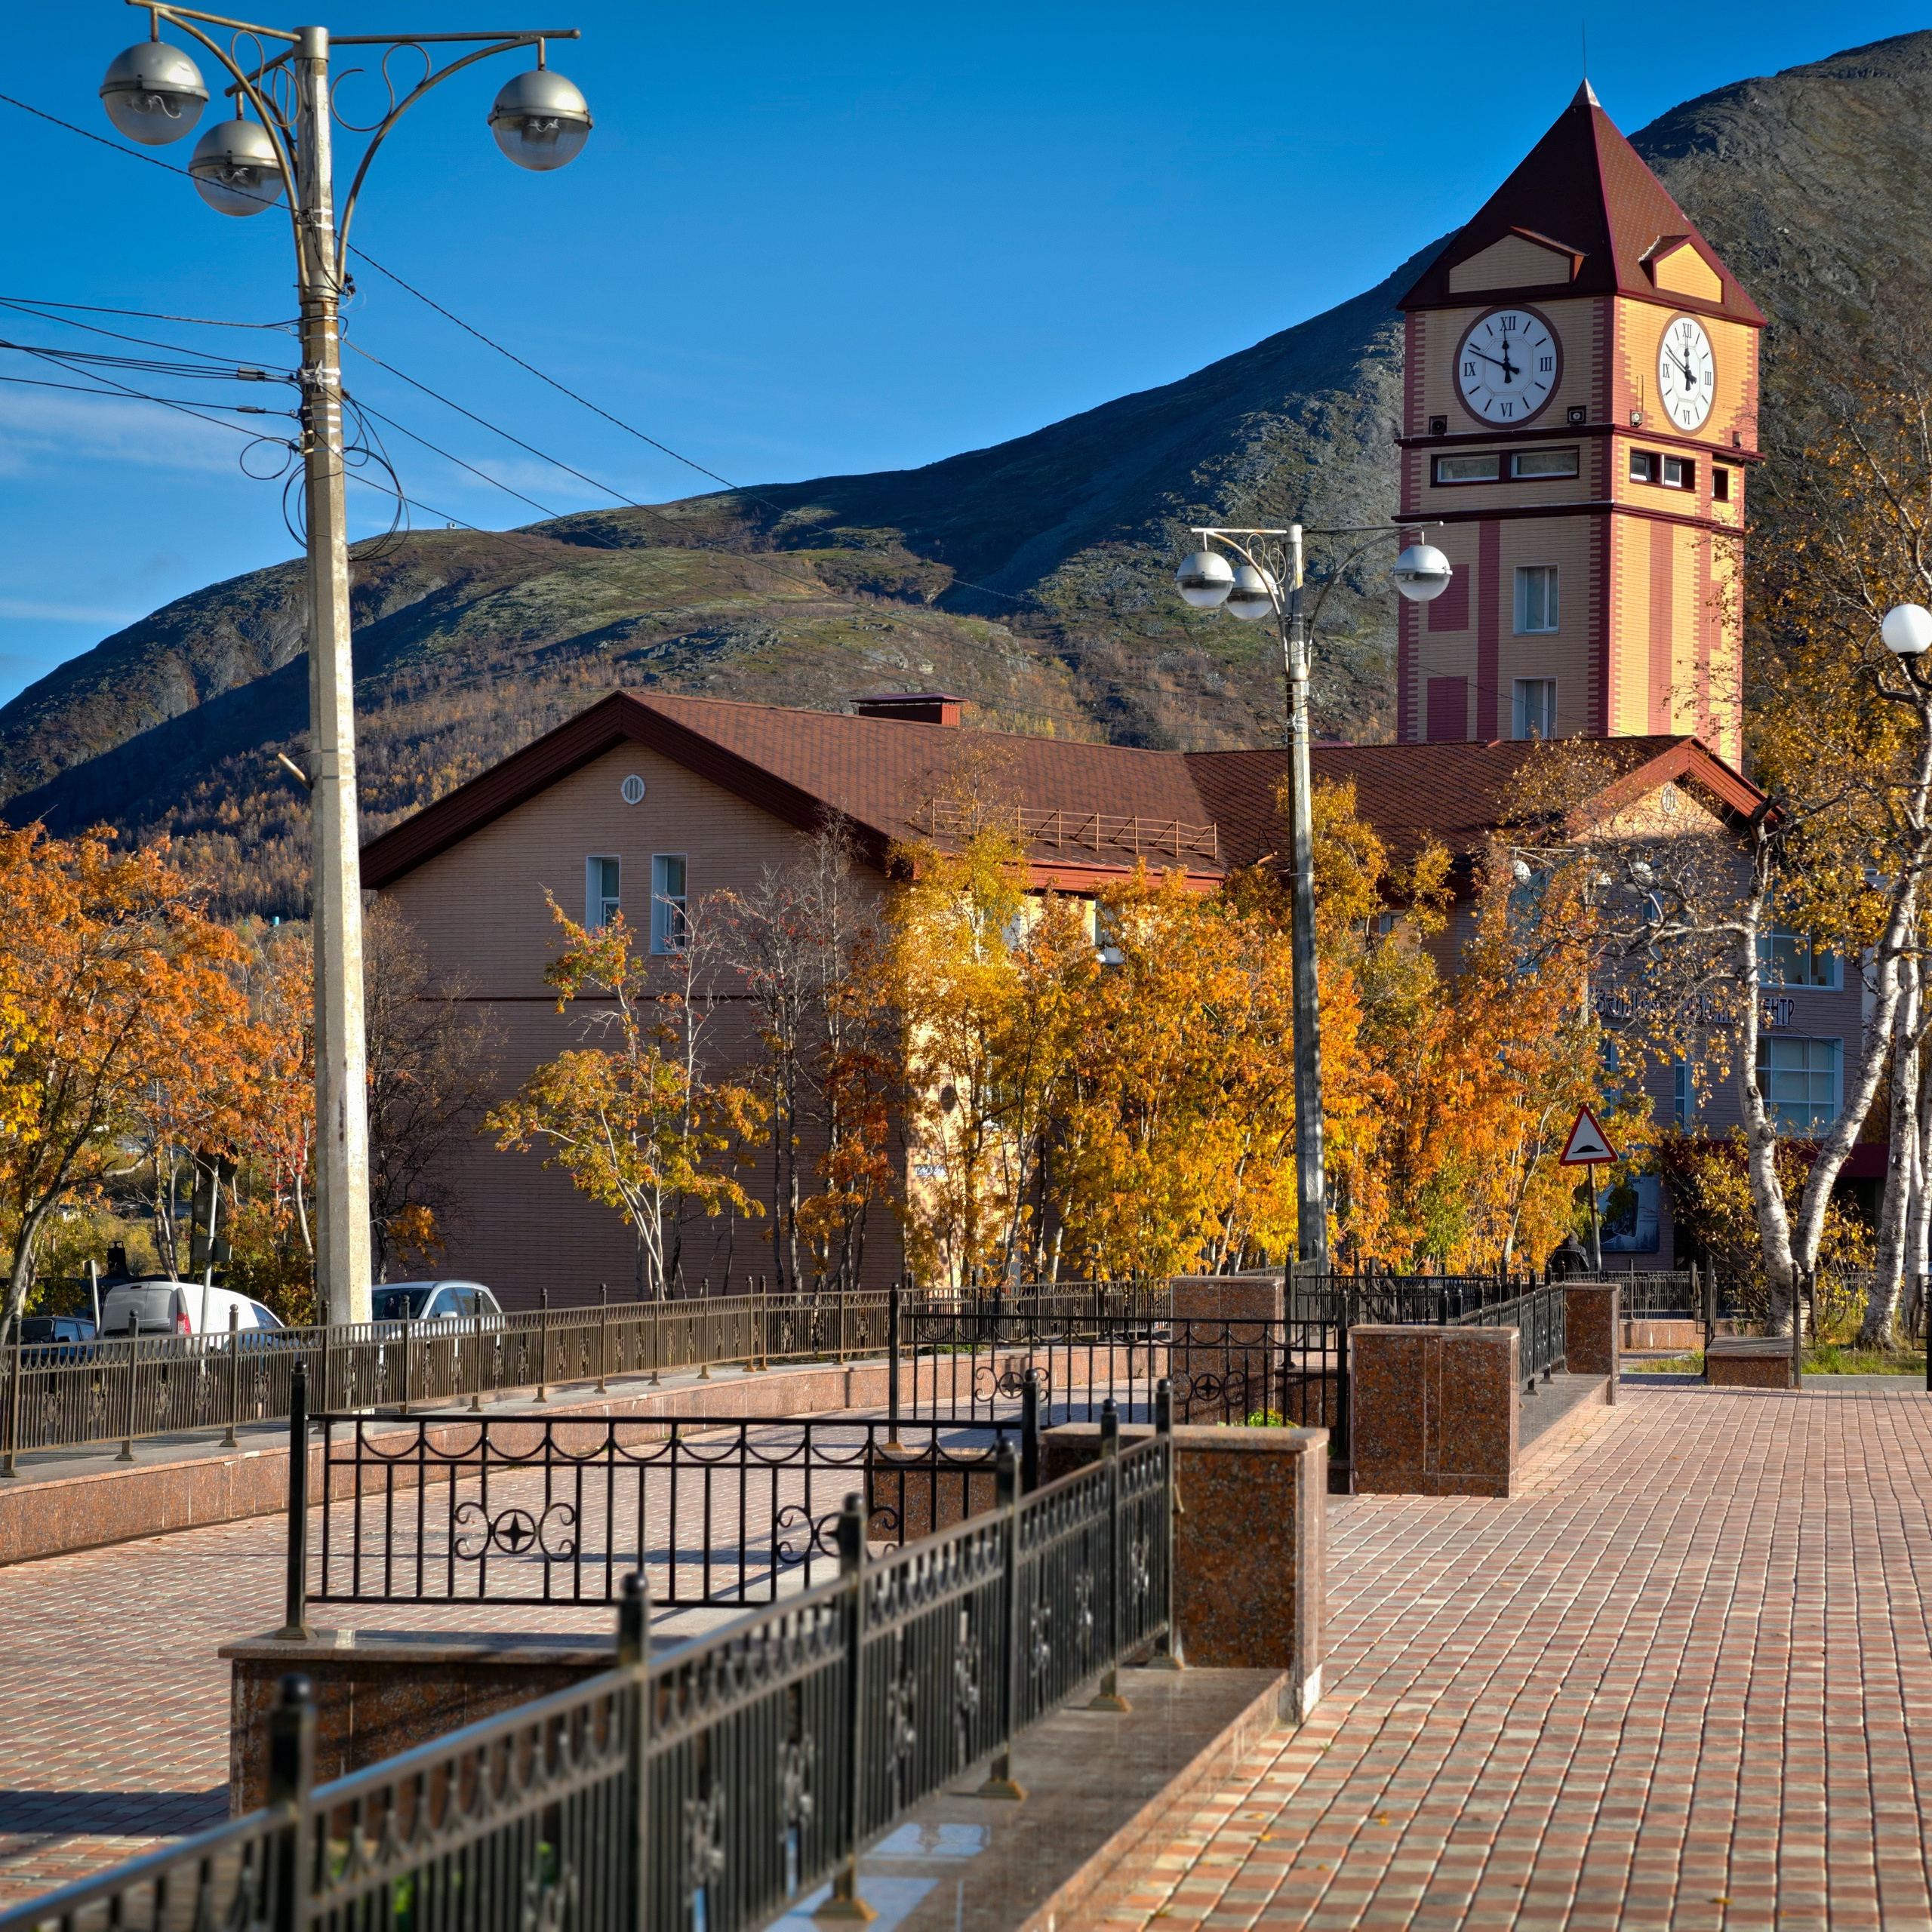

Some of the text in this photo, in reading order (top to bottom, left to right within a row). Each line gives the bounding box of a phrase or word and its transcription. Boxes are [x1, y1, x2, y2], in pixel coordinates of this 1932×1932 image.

[1500, 316, 1516, 331] XII
[1682, 323, 1692, 338] XII
[1464, 362, 1476, 377] IX
[1540, 357, 1552, 372] III
[1663, 363, 1670, 378] IX
[1500, 402, 1513, 417] VI
[1683, 410, 1690, 425] VI
